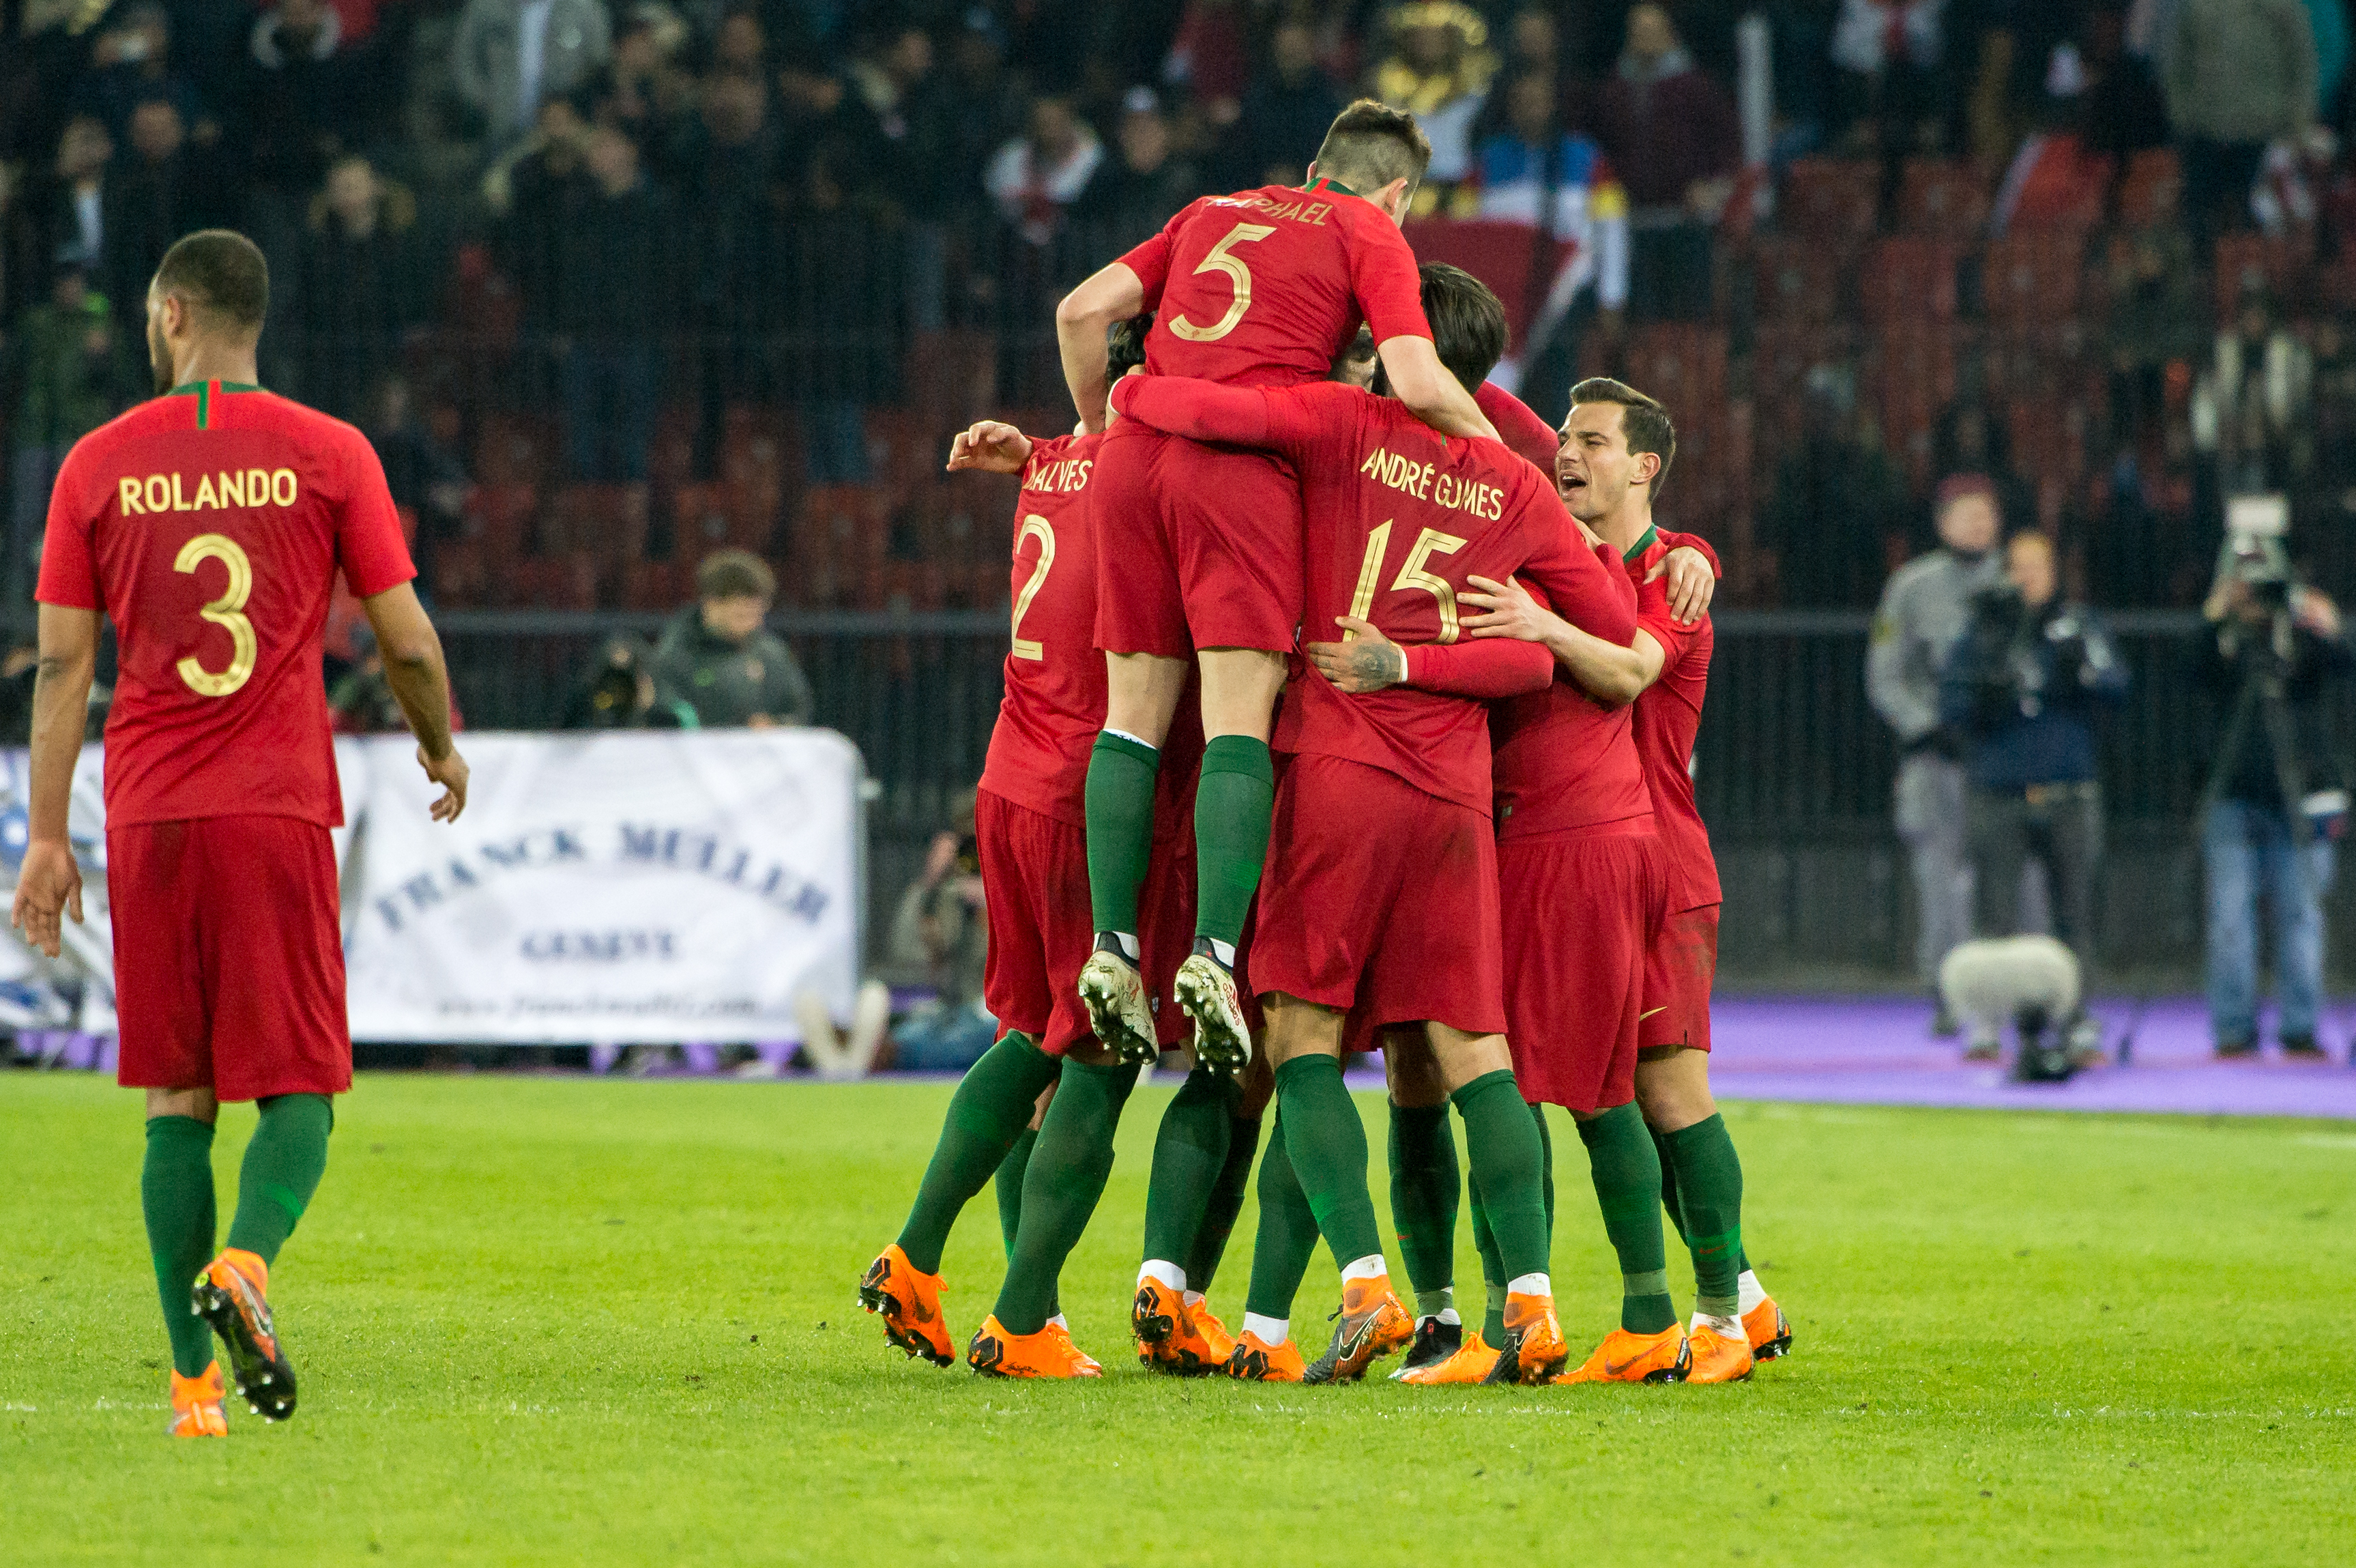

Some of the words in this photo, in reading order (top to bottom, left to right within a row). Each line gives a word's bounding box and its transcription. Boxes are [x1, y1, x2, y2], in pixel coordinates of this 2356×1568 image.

[1169, 222, 1278, 342] 5
[119, 468, 298, 517] ROLANDO
[1360, 446, 1436, 501] ANDRÉ
[1434, 473, 1504, 521] GOMES
[173, 533, 258, 697] 3
[1011, 514, 1056, 661] 2
[1342, 518, 1468, 643] 15
[376, 828, 587, 933] FRANCK
[617, 822, 830, 925] MULLER
